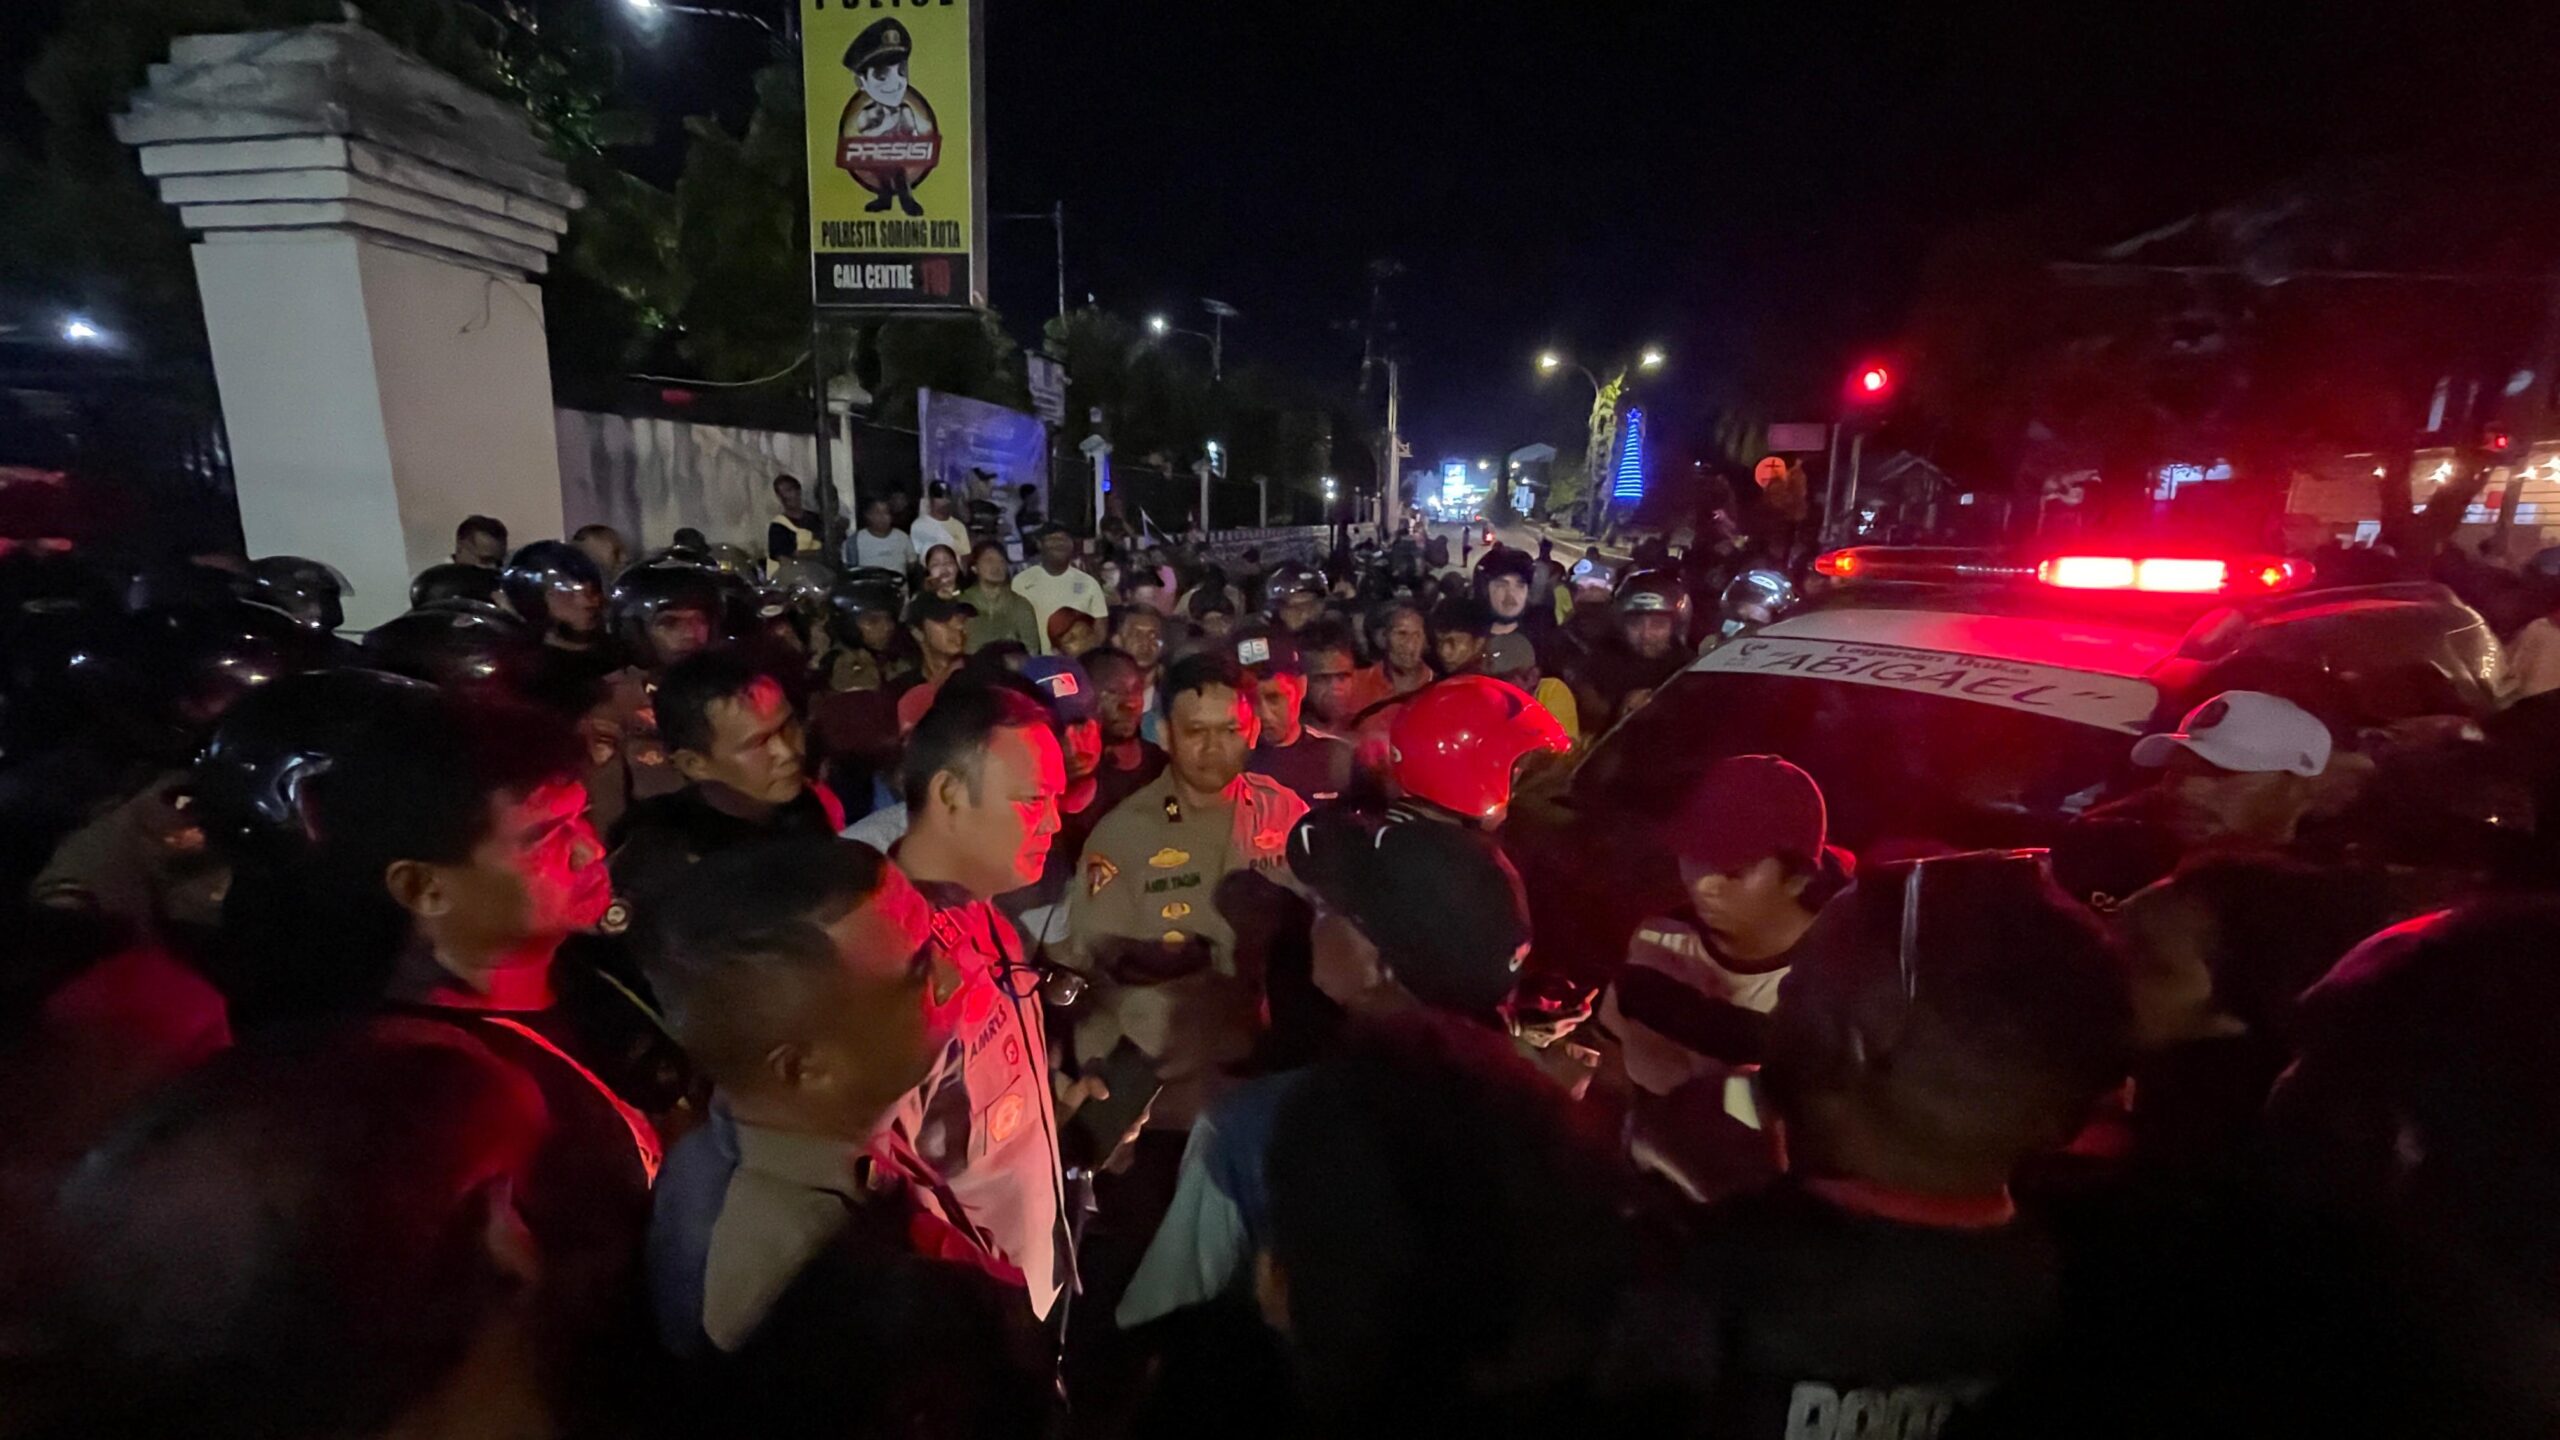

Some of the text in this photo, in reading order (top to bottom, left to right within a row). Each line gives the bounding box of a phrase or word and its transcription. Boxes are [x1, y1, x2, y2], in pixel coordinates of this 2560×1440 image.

[846, 142, 933, 161] PRESISI
[821, 219, 961, 248] POLRESTA SORONG KOTA
[833, 264, 863, 289] CALL
[865, 264, 914, 290] CENTRE
